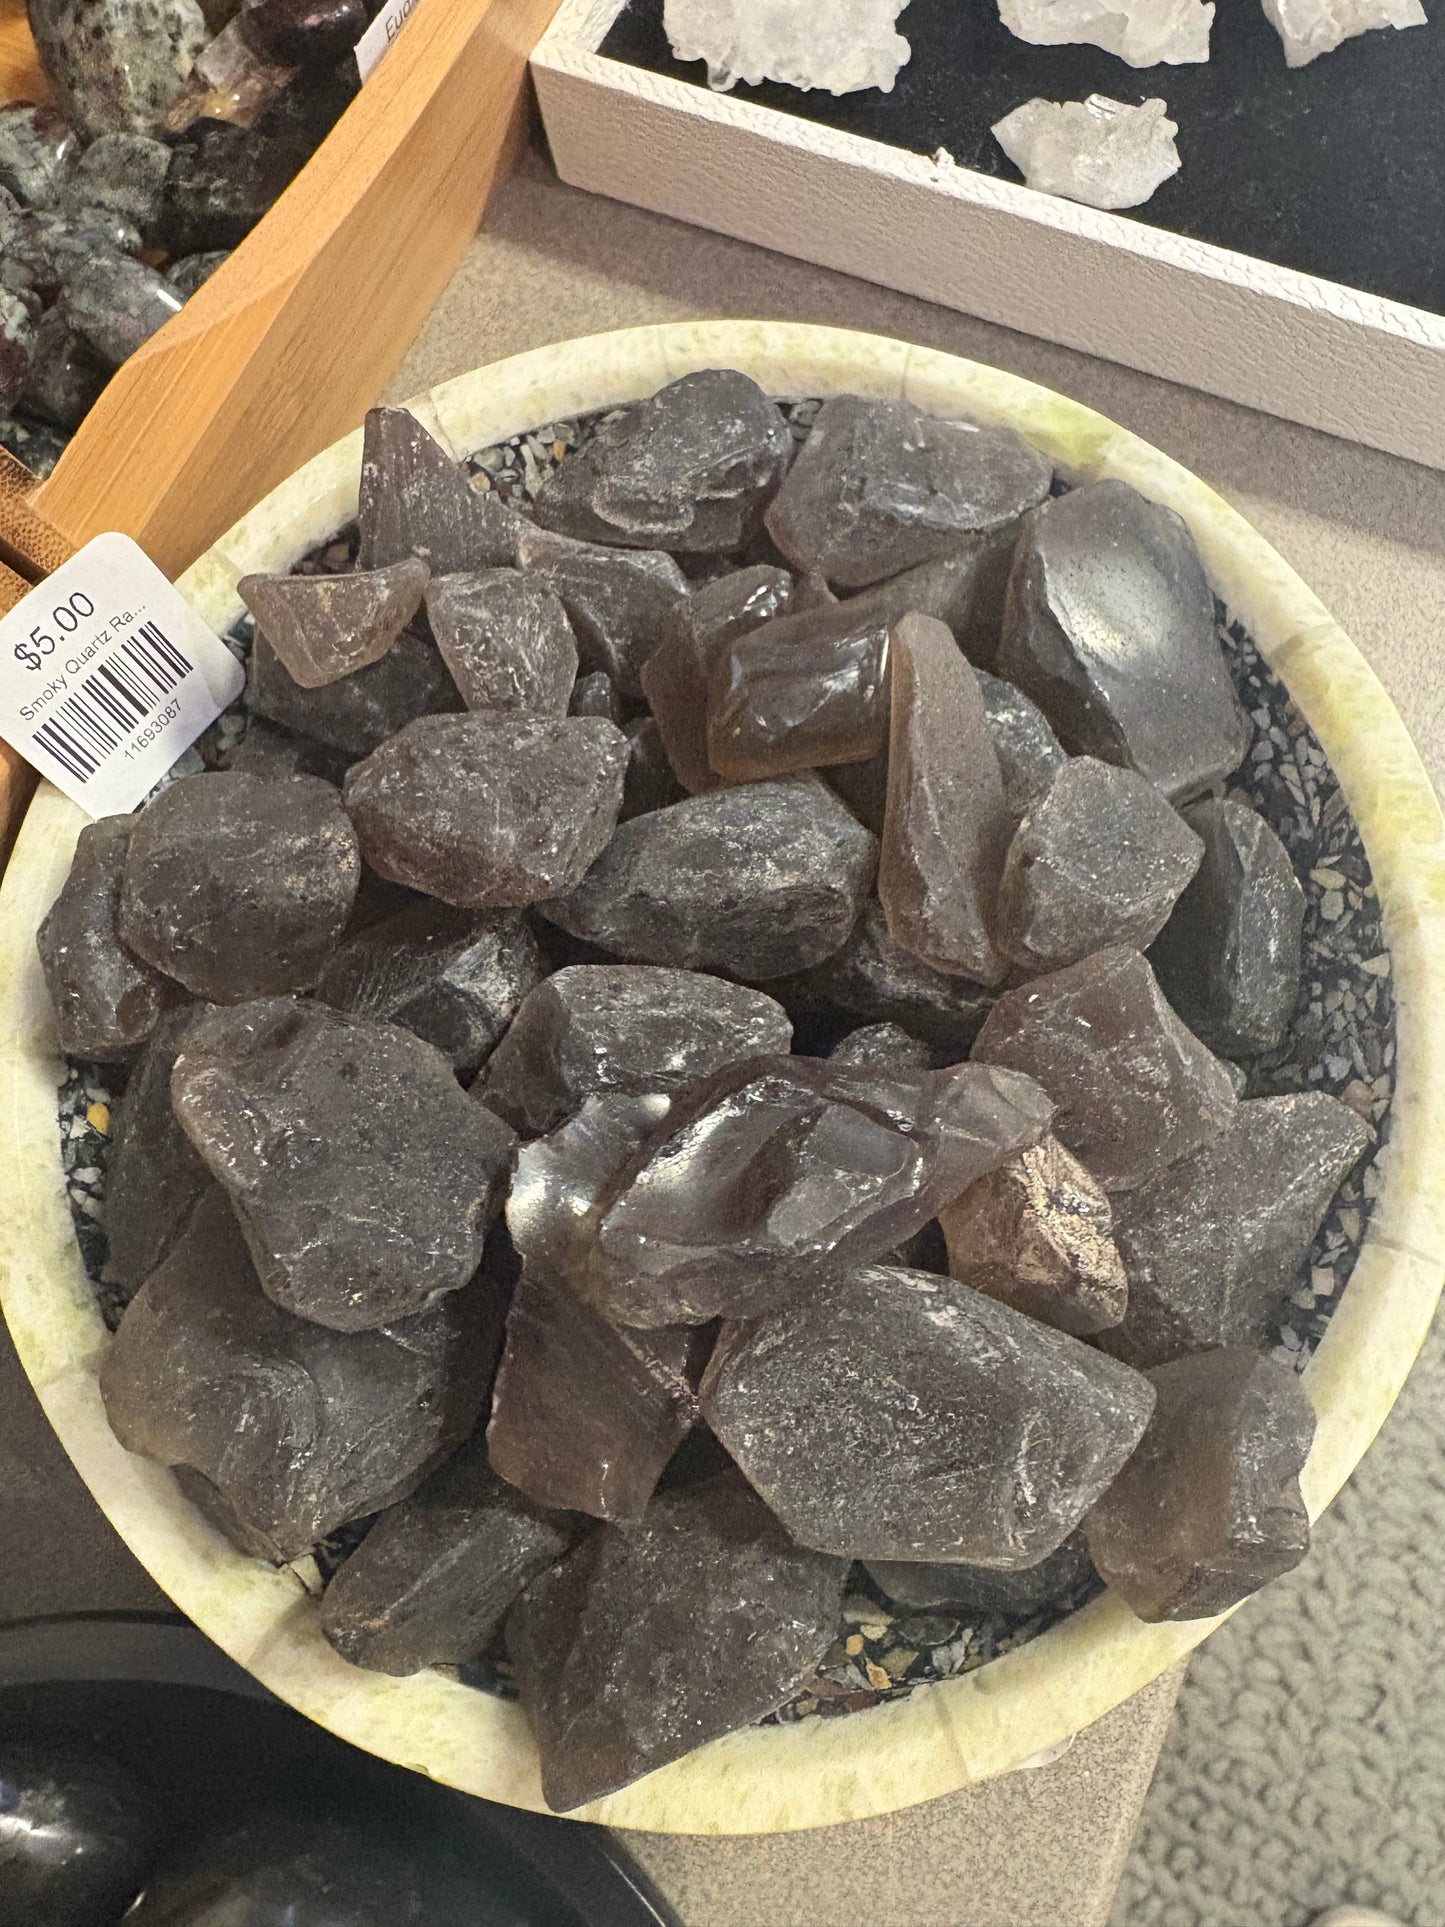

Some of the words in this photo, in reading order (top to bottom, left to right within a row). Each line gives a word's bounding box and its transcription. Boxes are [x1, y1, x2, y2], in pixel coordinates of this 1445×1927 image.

[14, 592, 94, 671] $5.00
[20, 674, 68, 721] Smoky
[65, 630, 112, 674] Quartz
[110, 605, 146, 632] Ra...
[124, 698, 182, 760] 11693087
